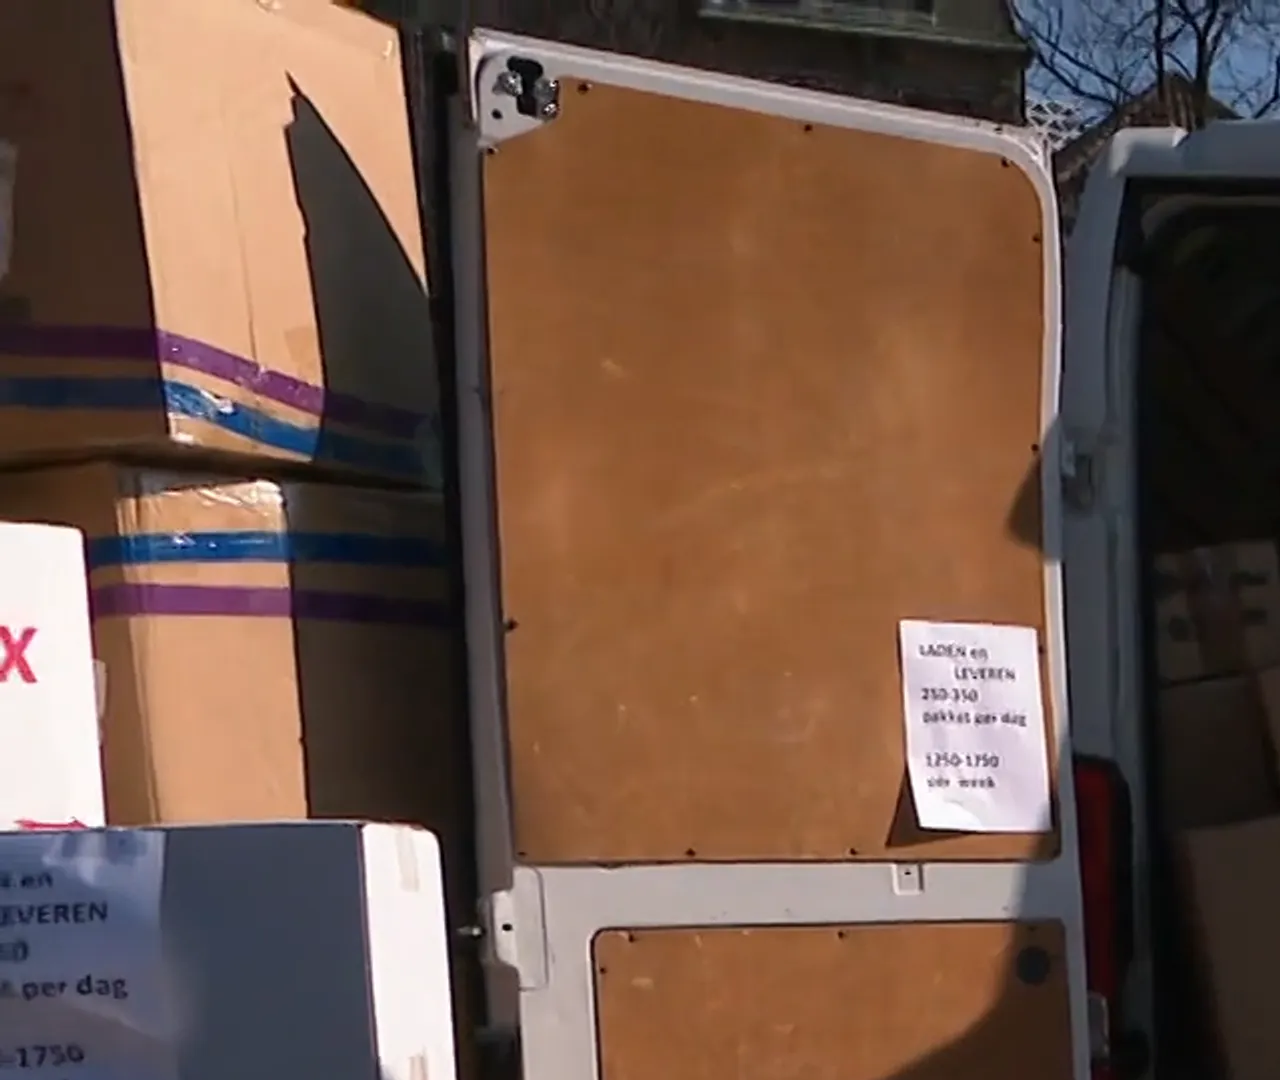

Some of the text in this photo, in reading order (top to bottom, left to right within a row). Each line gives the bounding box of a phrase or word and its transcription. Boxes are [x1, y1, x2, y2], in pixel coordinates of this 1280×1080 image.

[919, 643, 989, 661] LADEN en
[954, 666, 1016, 682] LEVEREN
[925, 751, 1000, 769] 1250-1750
[22, 979, 67, 1001] per
[75, 973, 129, 1000] dag
